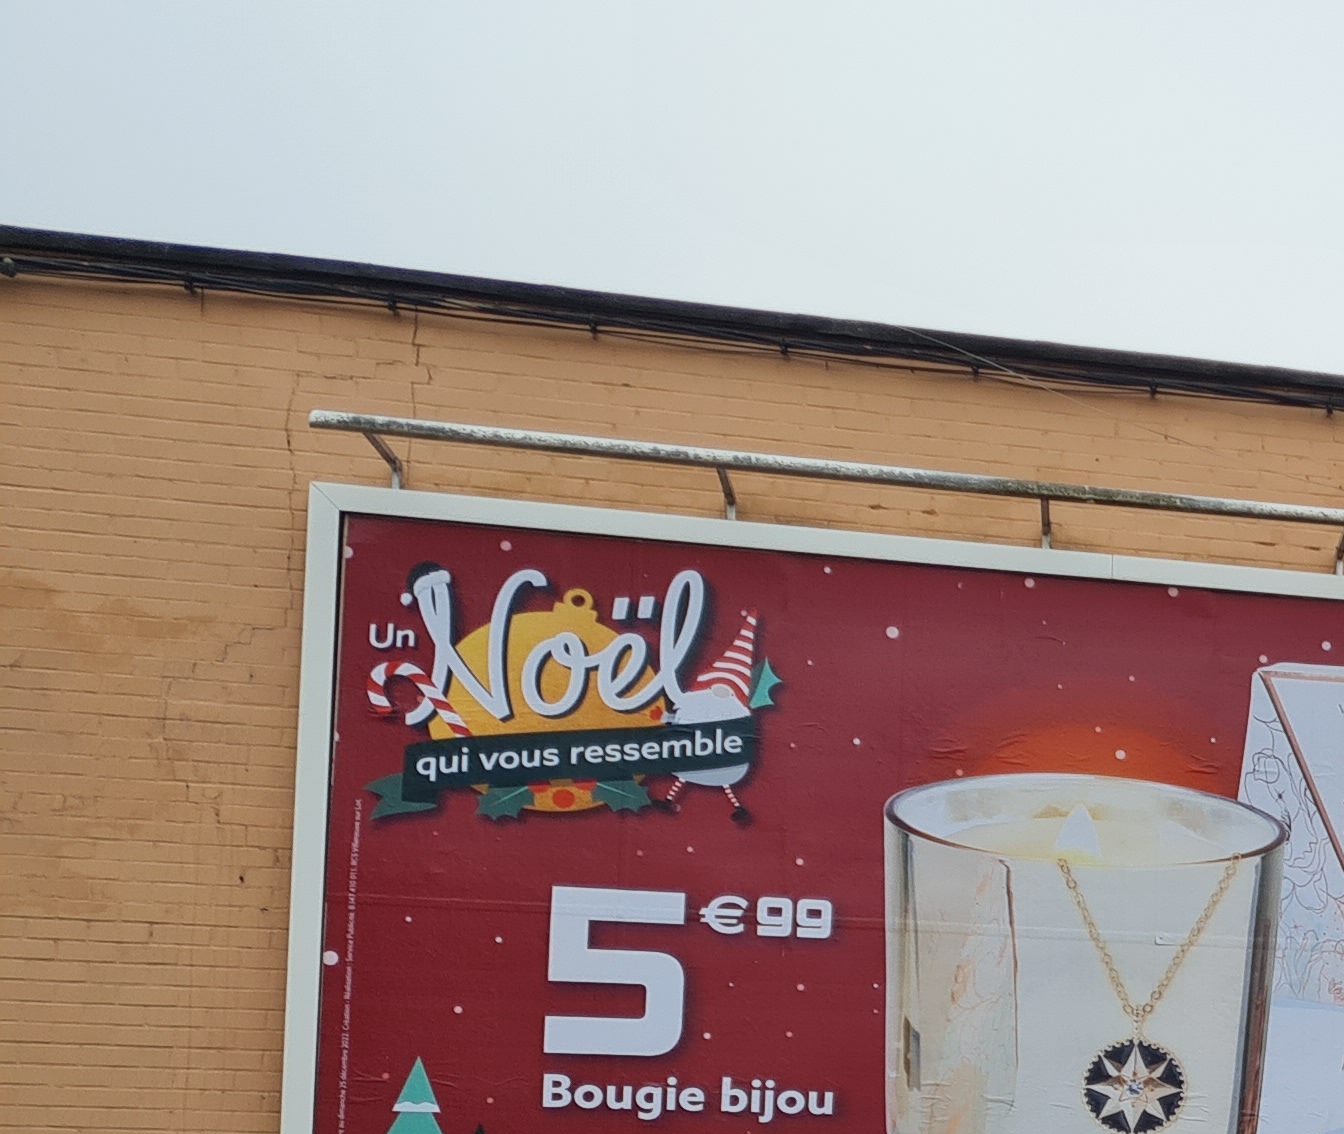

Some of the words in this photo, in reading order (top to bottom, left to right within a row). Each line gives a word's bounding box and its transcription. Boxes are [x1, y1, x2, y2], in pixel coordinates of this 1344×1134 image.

[368, 622, 416, 650] Un
[404, 568, 704, 727] Noël
[415, 746, 470, 782] qui
[478, 744, 561, 772] vous
[569, 728, 744, 765] ressemble
[541, 1073, 706, 1121] Bougie
[719, 1076, 835, 1124] bijou
